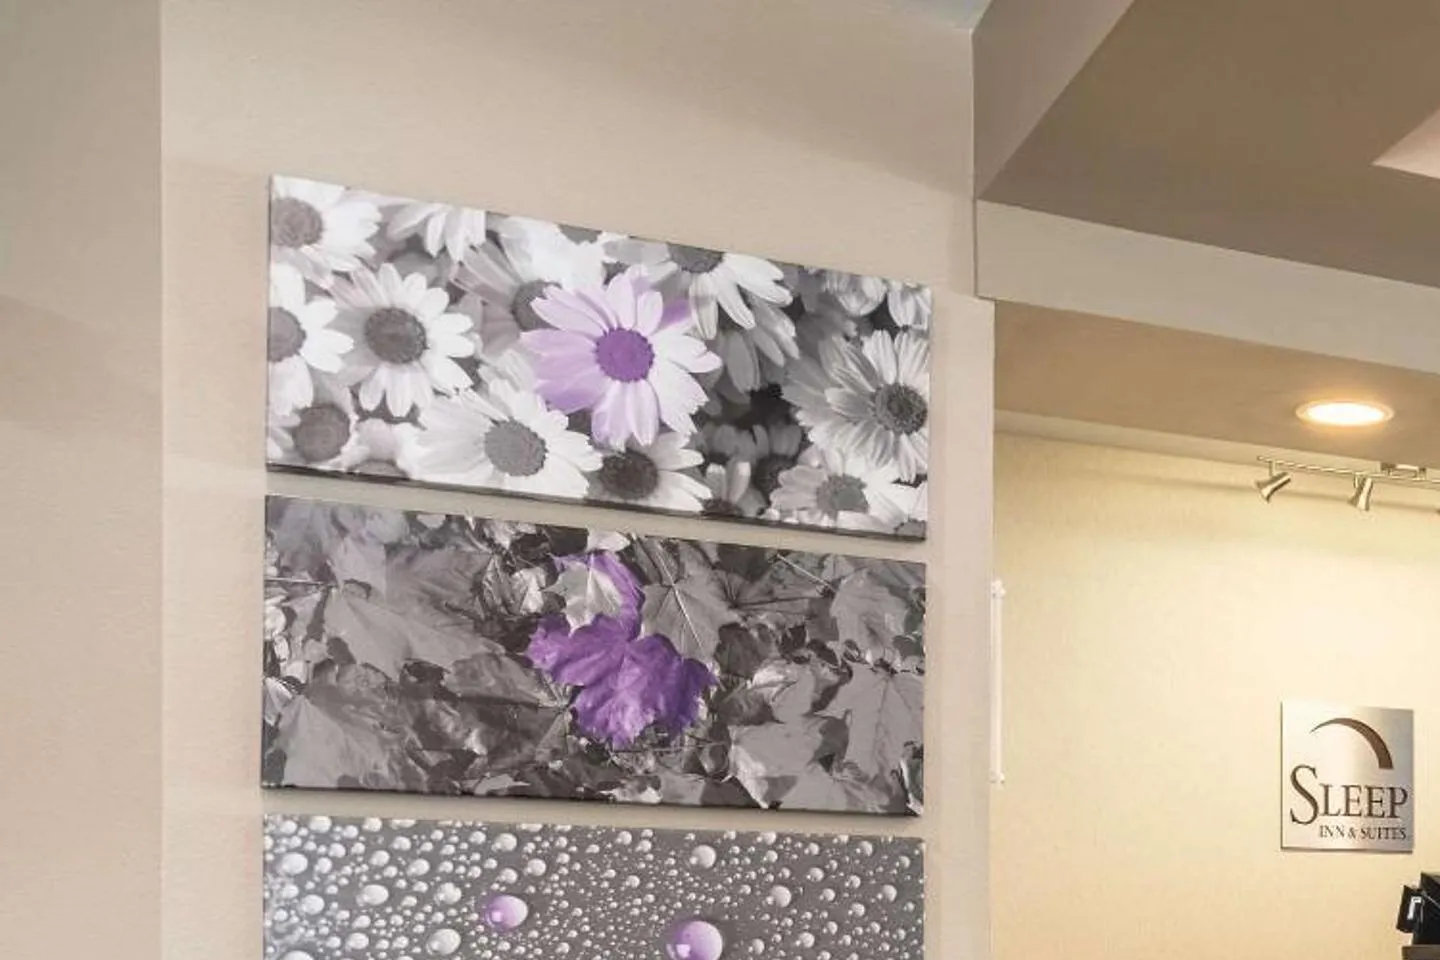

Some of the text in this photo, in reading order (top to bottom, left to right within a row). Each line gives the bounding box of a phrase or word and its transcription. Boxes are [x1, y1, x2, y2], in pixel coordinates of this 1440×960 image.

[1319, 825, 1407, 840] INN & SUITES
